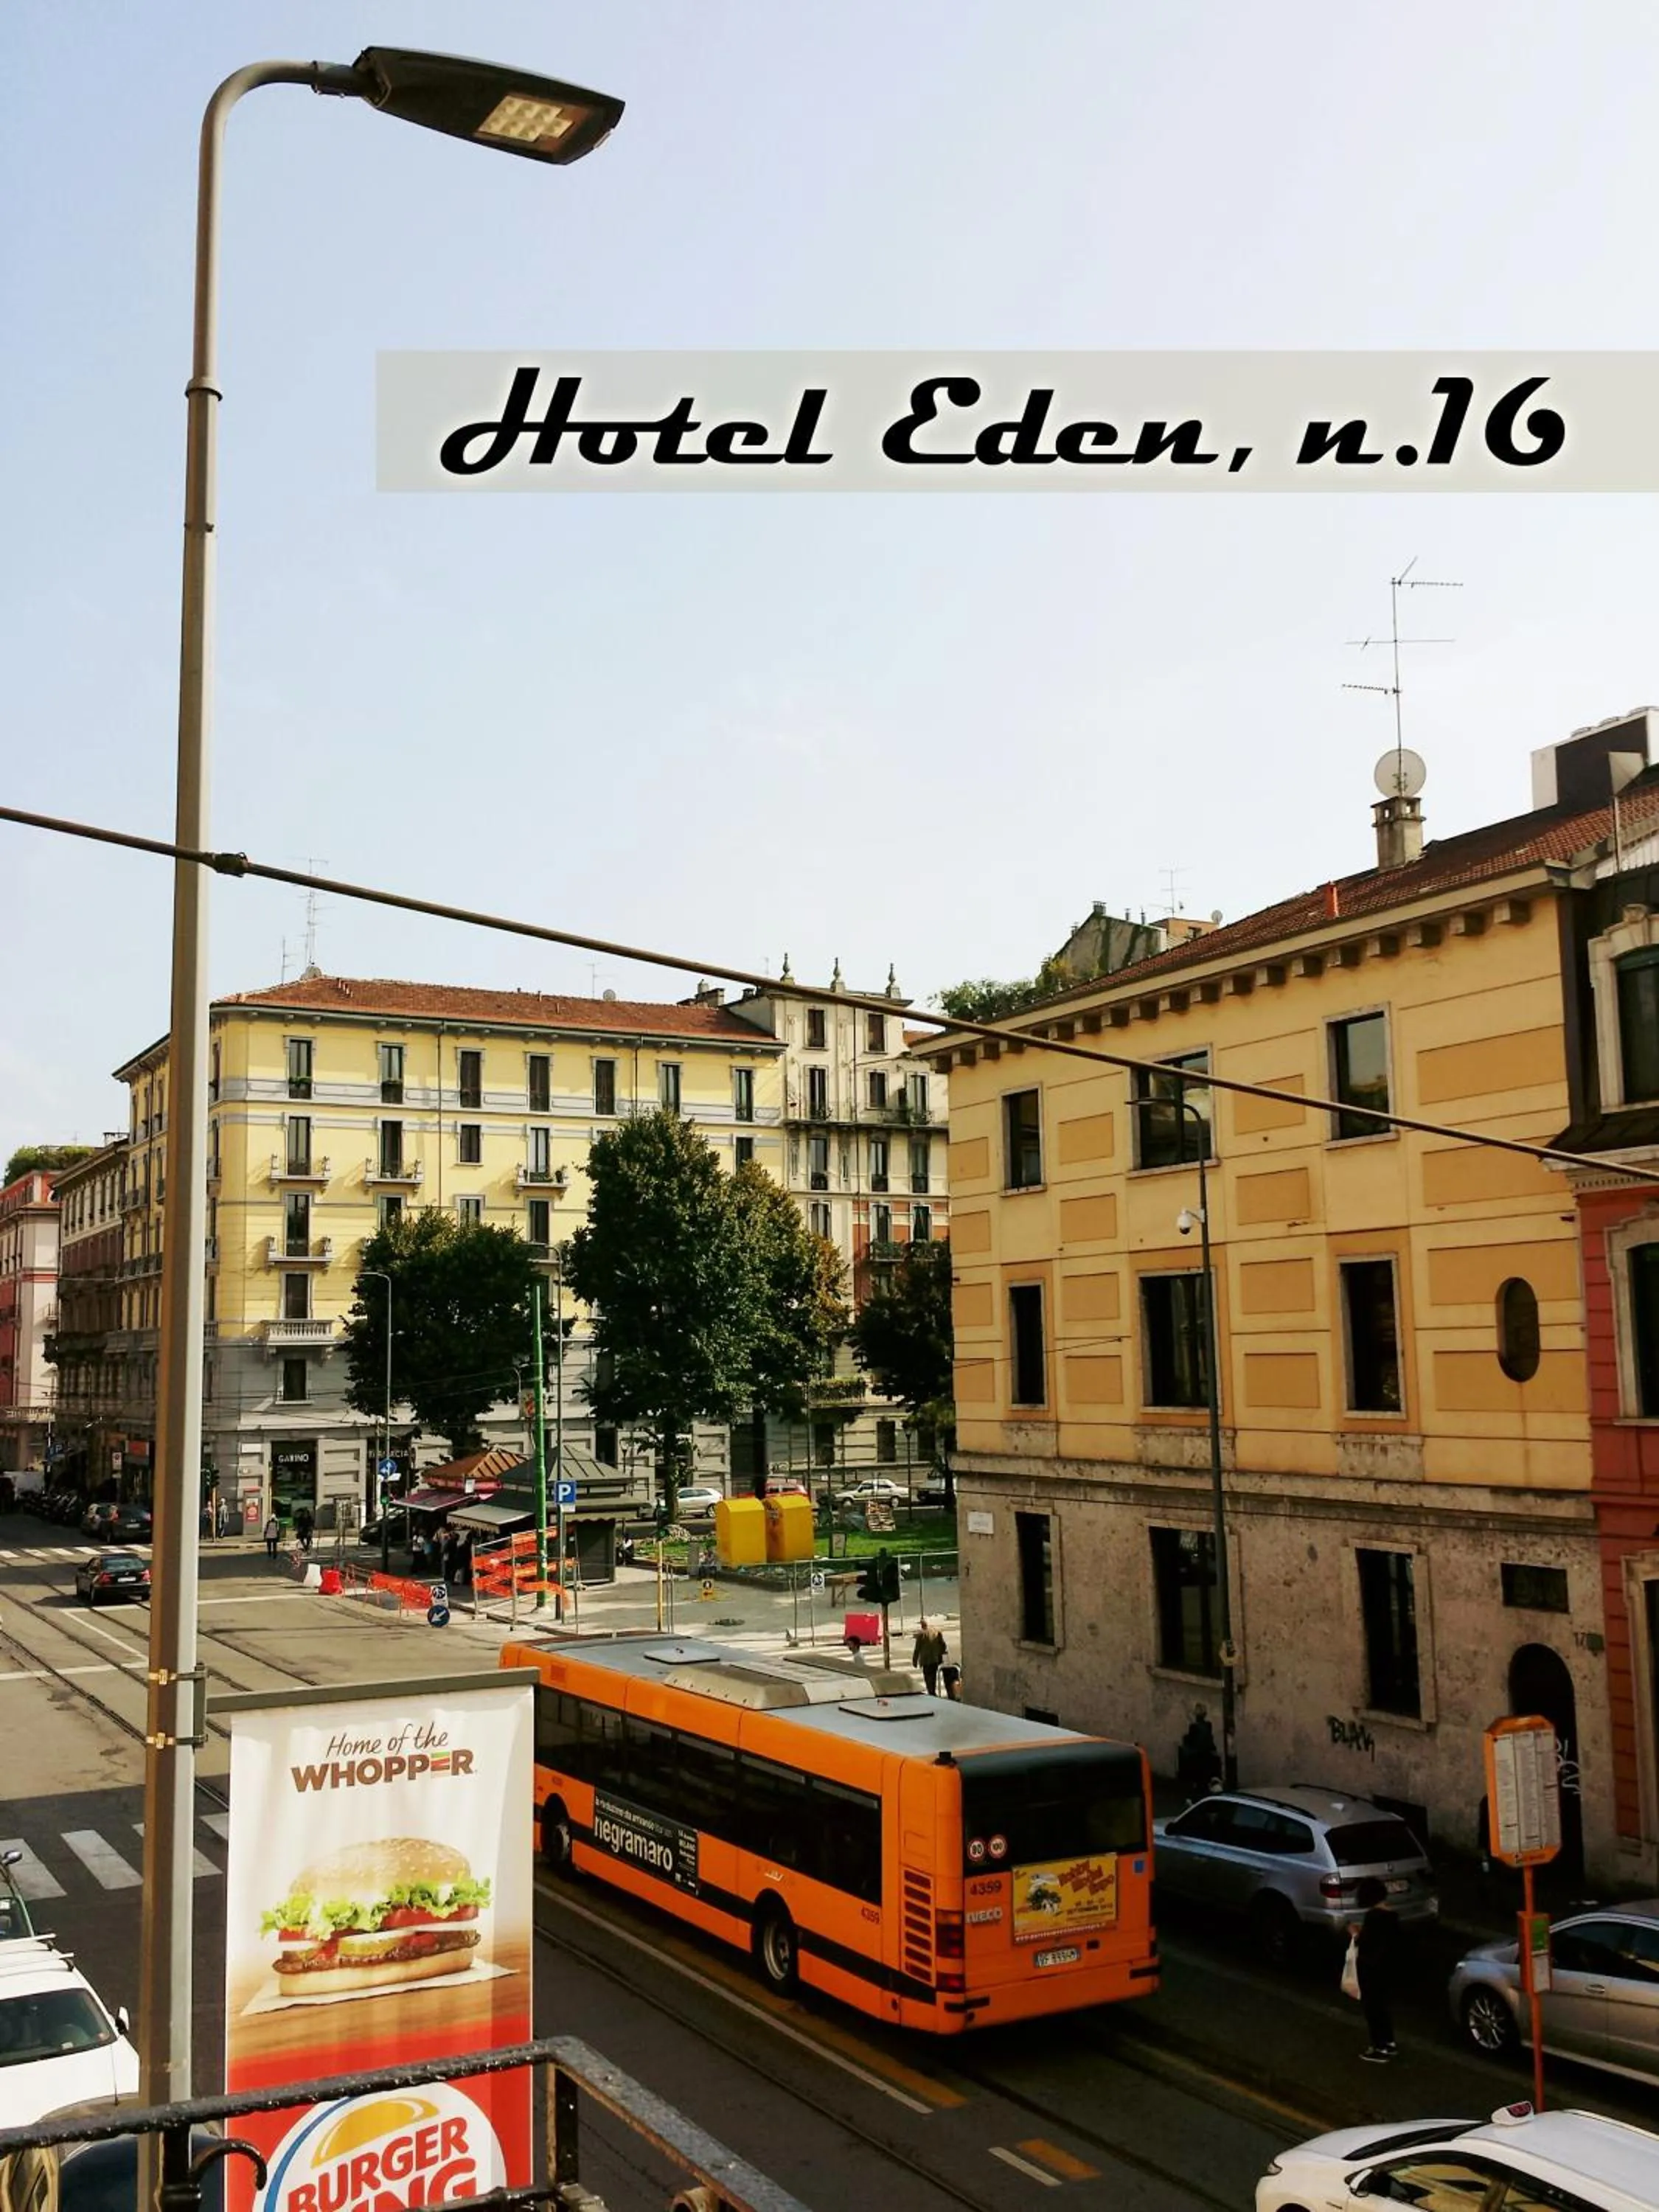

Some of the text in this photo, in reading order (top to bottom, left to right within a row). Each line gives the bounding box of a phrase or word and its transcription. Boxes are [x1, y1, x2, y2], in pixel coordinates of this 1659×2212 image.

[558, 1484, 571, 1502] P
[325, 1721, 449, 1758] Home of the
[291, 1748, 474, 1792] WHOPPER
[594, 1815, 673, 1872] negramaro
[970, 1880, 1002, 1896] 4359
[860, 1906, 880, 1924] 4359
[965, 1906, 1003, 1924] IVECO
[288, 2117, 470, 2212] BURGER
